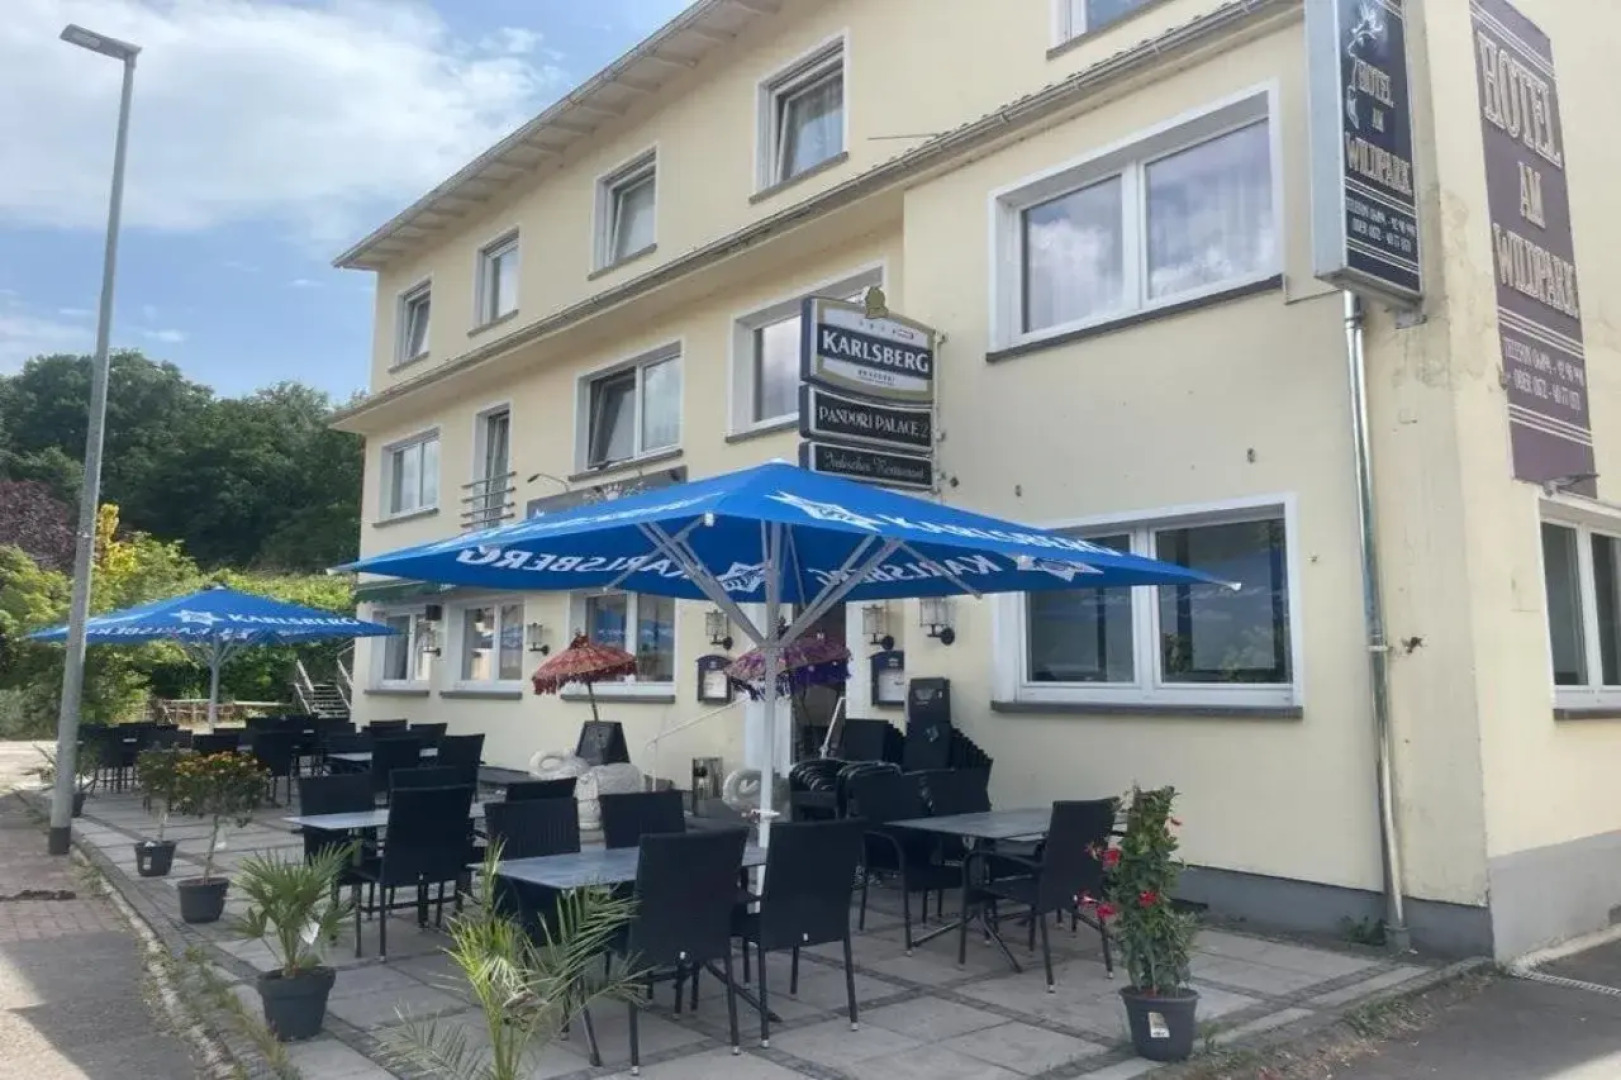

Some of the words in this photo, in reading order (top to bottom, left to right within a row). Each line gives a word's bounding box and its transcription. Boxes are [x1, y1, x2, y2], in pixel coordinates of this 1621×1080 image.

[1478, 32, 1563, 168] HOTEL
[1518, 161, 1546, 229] AM
[1492, 222, 1579, 319] WILDPARK
[823, 330, 929, 373] KARLSBERG
[227, 613, 361, 625] KARLSBERG
